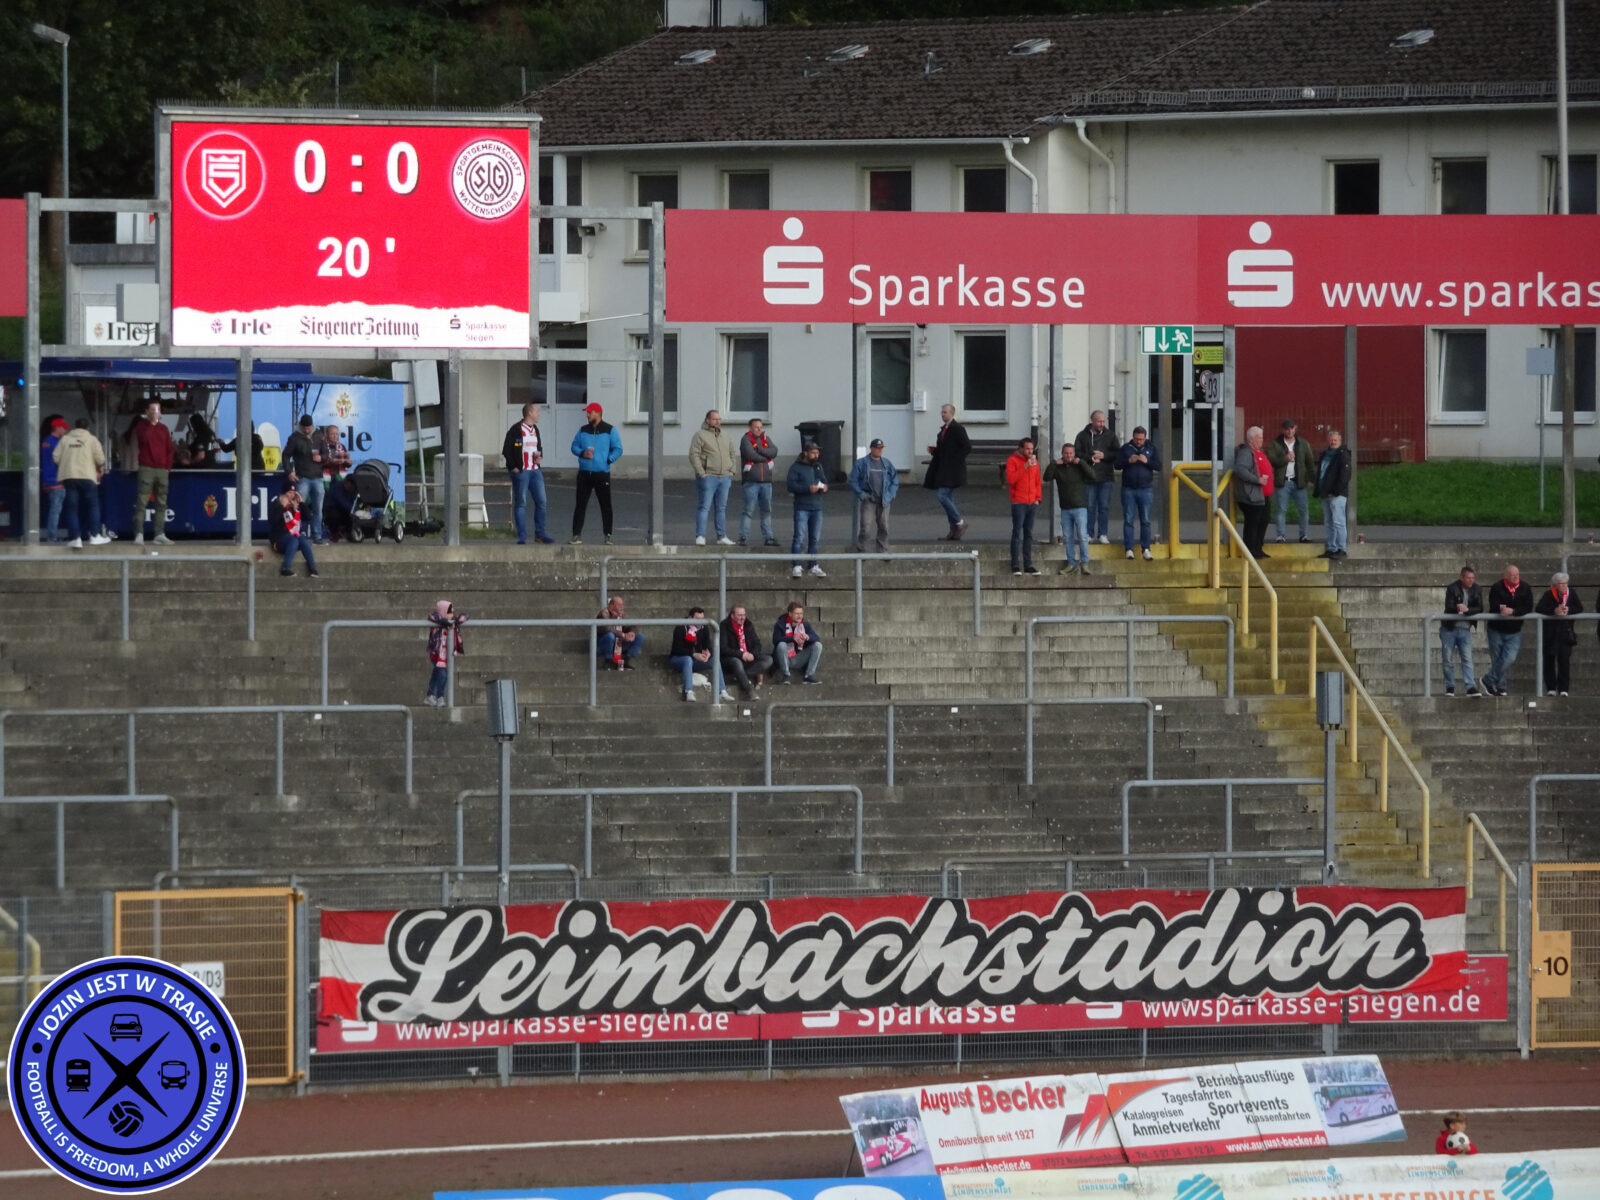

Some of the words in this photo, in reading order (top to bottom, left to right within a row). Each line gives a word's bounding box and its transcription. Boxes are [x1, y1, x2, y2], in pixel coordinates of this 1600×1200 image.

[294, 140, 326, 193] 0
[387, 142, 418, 194] 0
[848, 264, 1086, 316] Sparkasse
[230, 318, 272, 336] Irle
[366, 886, 1416, 1022] Leimbachstadion
[1543, 957, 1569, 976] 10
[857, 1004, 1016, 1033] Sparkasse
[1196, 1069, 1295, 1088] Betriebsausflüge
[920, 1087, 975, 1114] August
[976, 1081, 1066, 1114] Becker
[1162, 1089, 1232, 1105] Tagesfahrten
[1122, 1107, 1184, 1122] Katalogreisen
[1208, 1097, 1290, 1119] Sportevents
[1245, 1111, 1311, 1125] Klassenfahrten
[1132, 1118, 1221, 1136] Anmietverkehr
[938, 1134, 995, 1149] Omnibusreisen
[997, 1132, 1013, 1142] seit
[1014, 1129, 1035, 1141] 1927
[1225, 1133, 1327, 1153] www.august-becker.de
